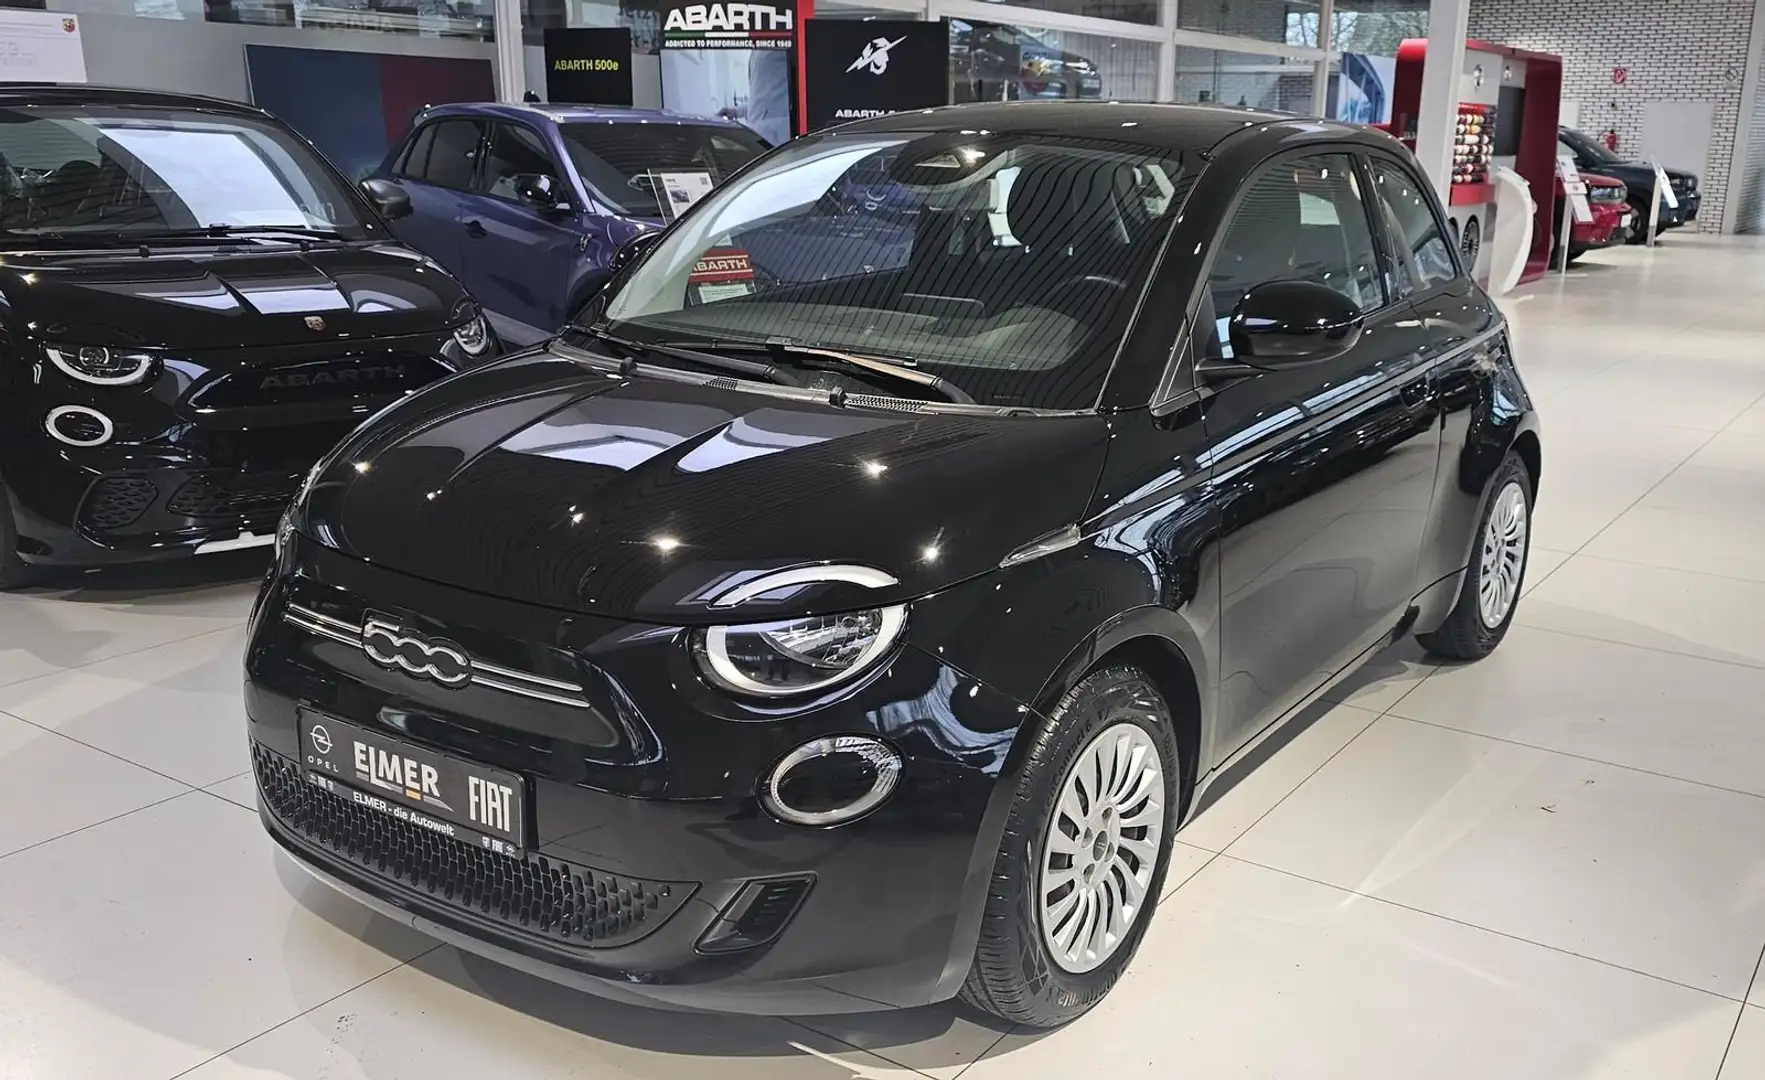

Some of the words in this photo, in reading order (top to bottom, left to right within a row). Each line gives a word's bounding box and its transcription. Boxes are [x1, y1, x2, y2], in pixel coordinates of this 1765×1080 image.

[663, 3, 793, 31] ABARTH
[664, 39, 696, 48] ADDICTED
[697, 39, 705, 48] TO
[706, 39, 755, 49] PERFORMANCE,
[755, 39, 776, 48] SINCE
[554, 59, 593, 71] ABARTH
[594, 58, 619, 71] 500e
[834, 108, 885, 118] ABARTH
[258, 365, 406, 389] ABARTH
[362, 617, 469, 683] 500
[307, 755, 340, 773] OPEL
[353, 740, 441, 797] ELMER
[353, 791, 388, 812] ELMER
[393, 806, 408, 821] die
[410, 811, 456, 836] Autowelt
[468, 775, 513, 832] FIAT
